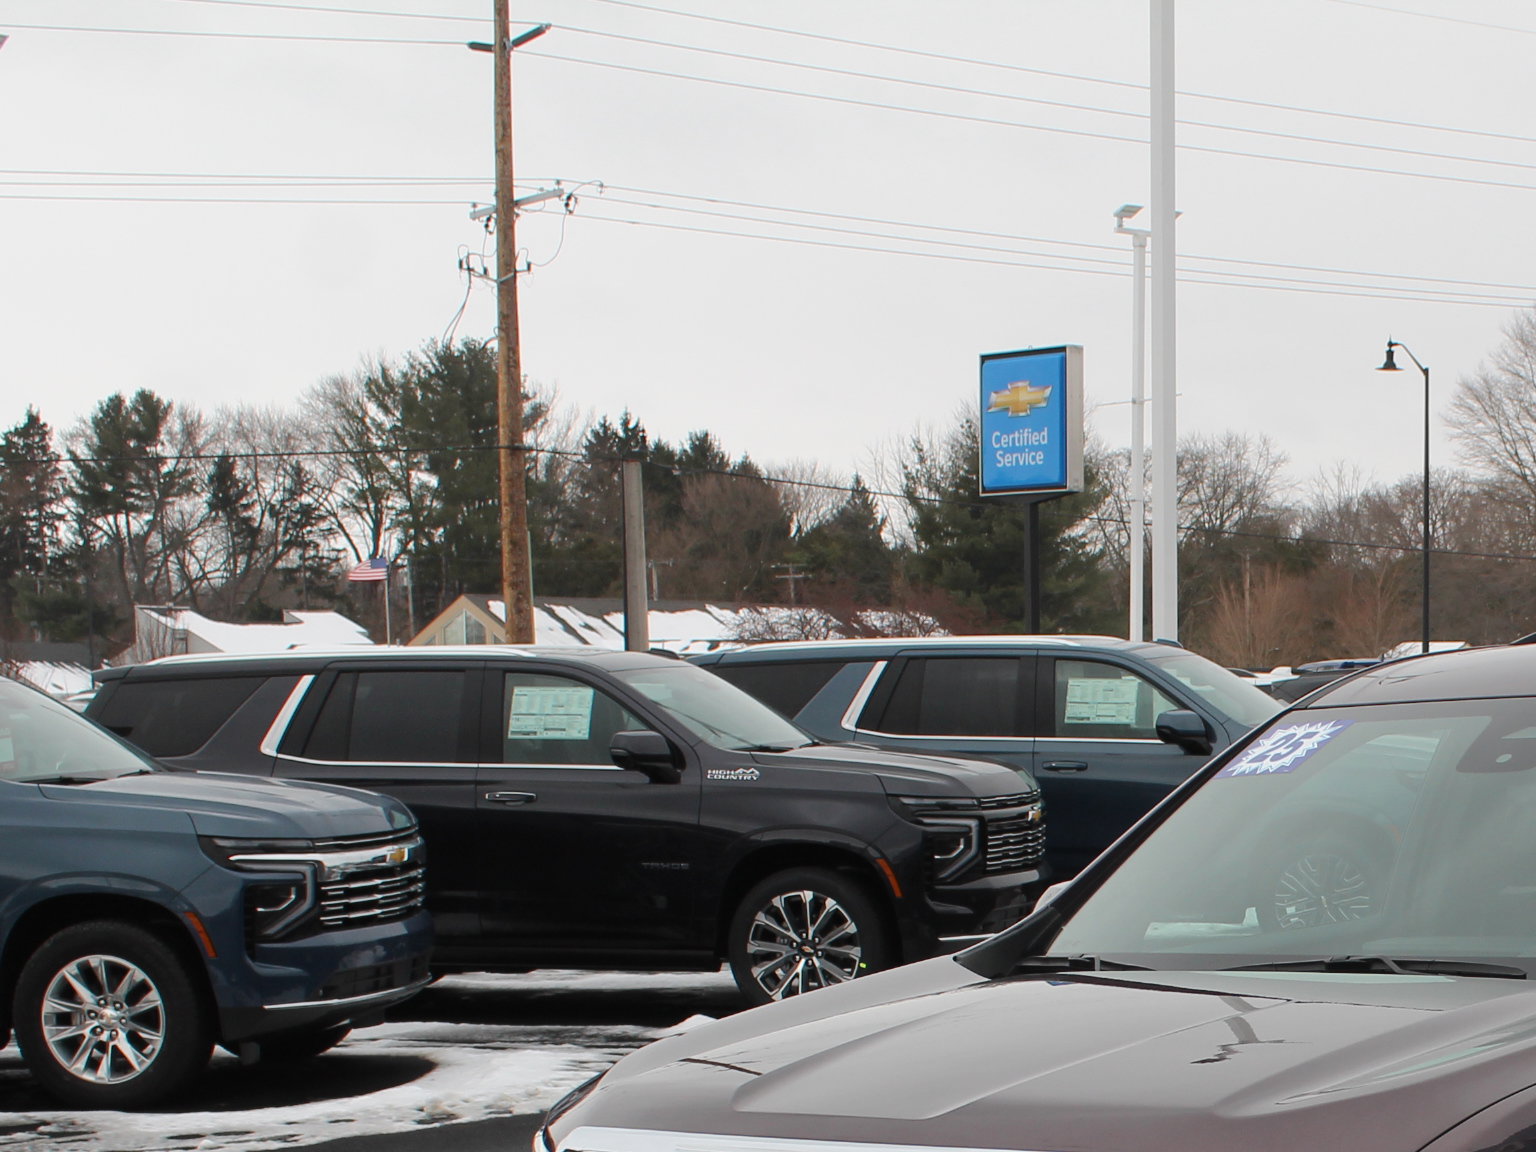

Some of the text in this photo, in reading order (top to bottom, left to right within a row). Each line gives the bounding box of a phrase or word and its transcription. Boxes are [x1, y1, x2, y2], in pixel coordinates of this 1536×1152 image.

[991, 427, 1048, 448] Certified
[996, 449, 1044, 467] Service
[1246, 731, 1322, 763] 25
